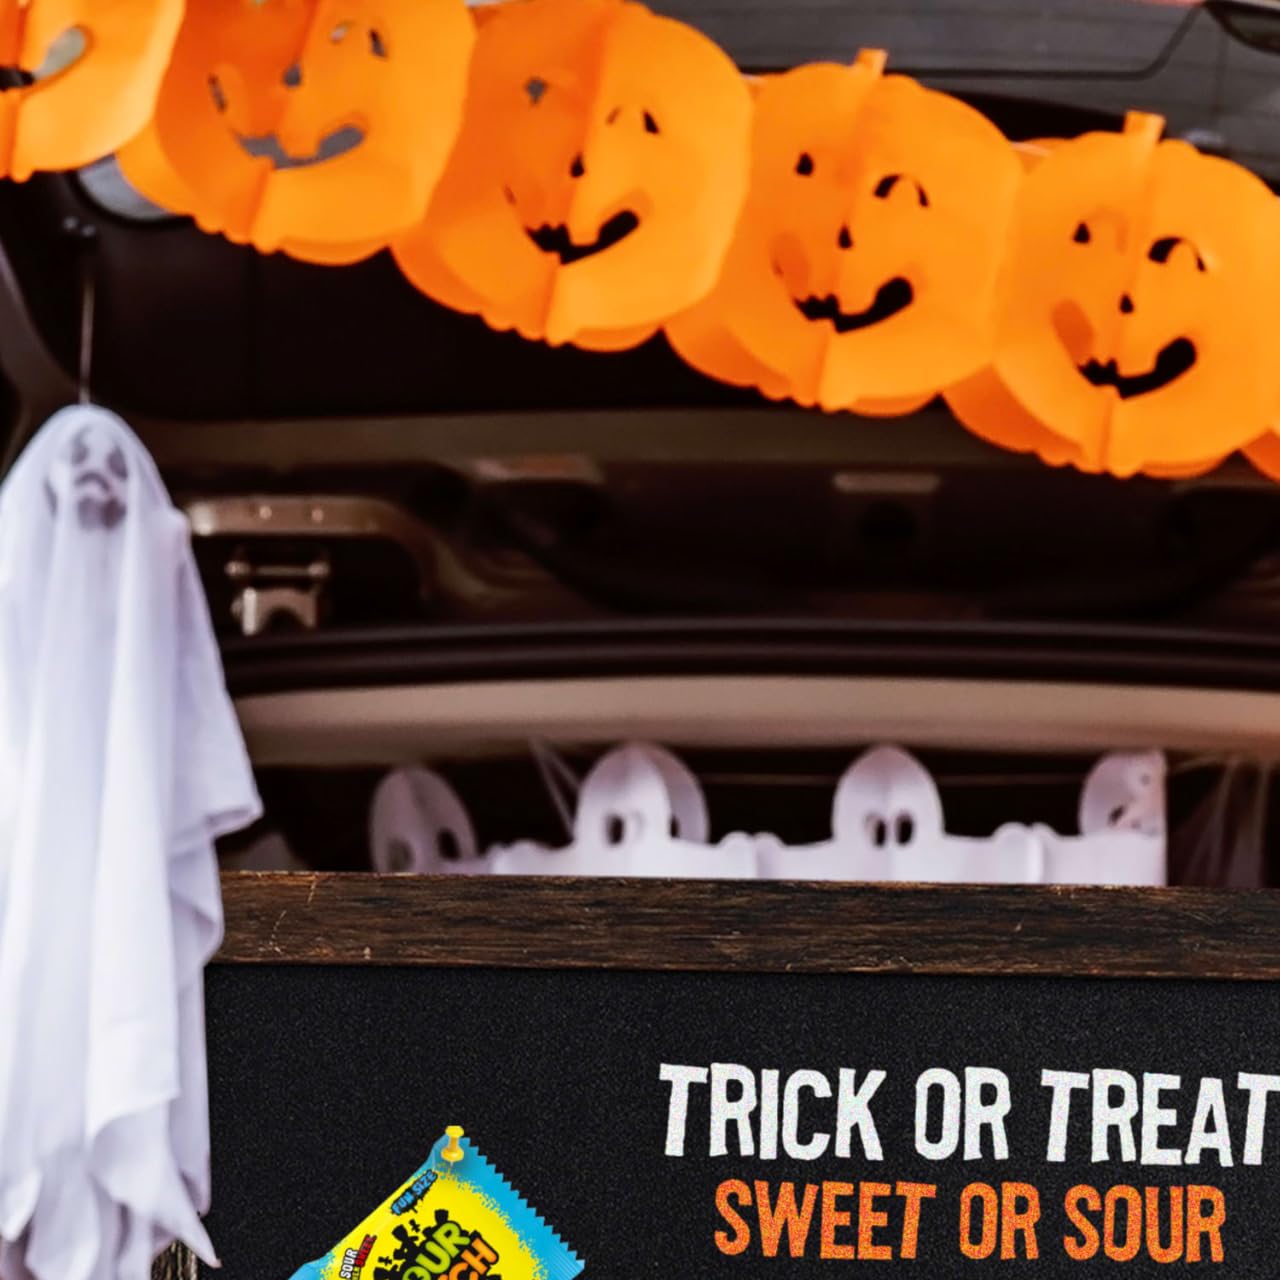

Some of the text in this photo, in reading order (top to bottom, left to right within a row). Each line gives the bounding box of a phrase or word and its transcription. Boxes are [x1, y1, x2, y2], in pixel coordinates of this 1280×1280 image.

[659, 1062, 887, 1161] TRICK
[914, 1066, 1012, 1161] OR
[392, 1170, 437, 1215] FUN SIZE
[714, 1179, 1226, 1263] SWEET OR SOUR
[340, 1249, 358, 1279] SOUR
